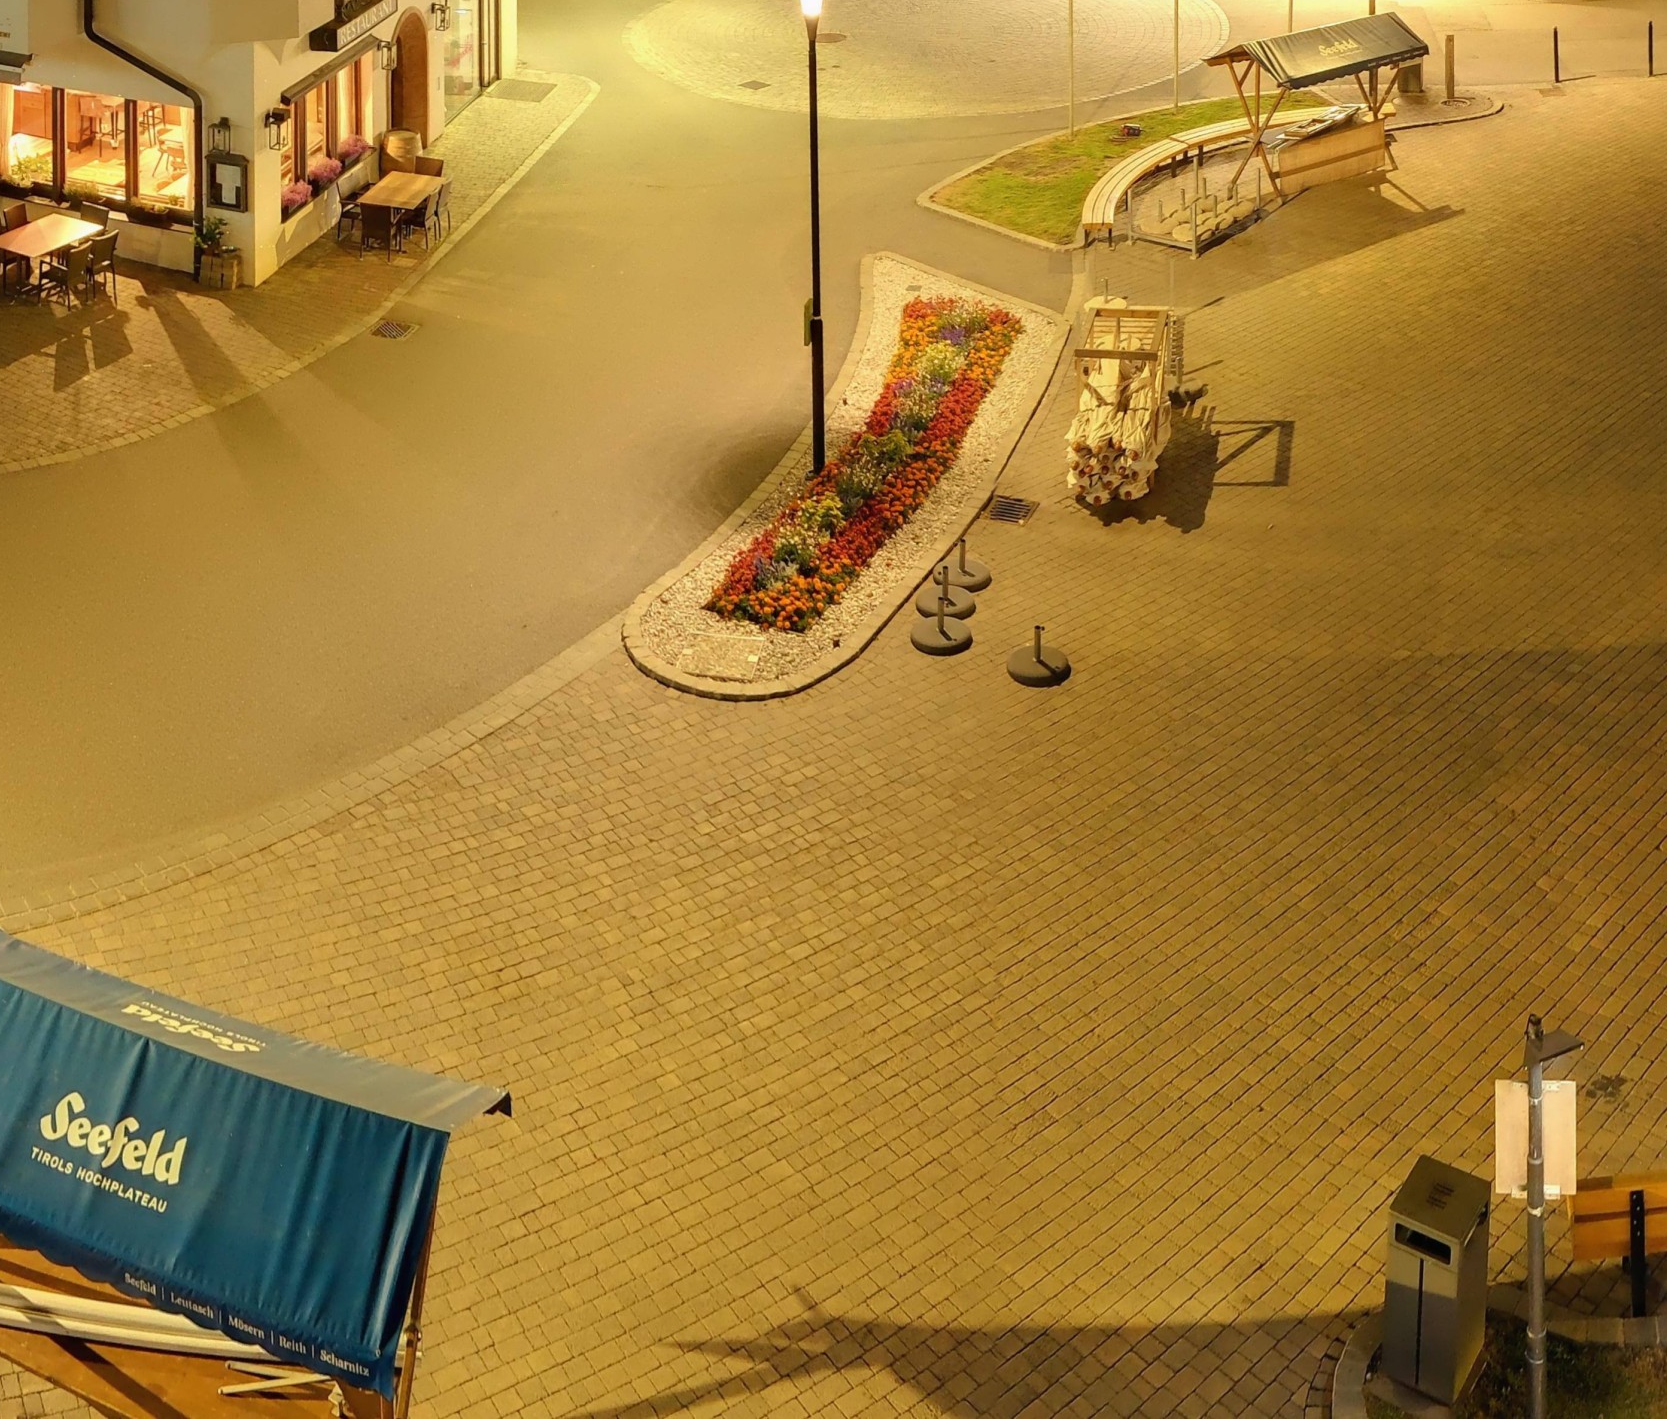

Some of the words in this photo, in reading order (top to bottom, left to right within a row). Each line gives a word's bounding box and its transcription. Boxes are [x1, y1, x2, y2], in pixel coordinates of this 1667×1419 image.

[1318, 38, 1360, 57] Seefeld
[121, 1002, 265, 1054] Seefeld
[140, 1000, 224, 1036] HOCHPLATEAU
[226, 1031, 267, 1048] TIROLS
[39, 1091, 188, 1185] Seefeld
[30, 1145, 74, 1175] TIROLS
[76, 1165, 168, 1214] HOCHPLATEAU
[124, 1272, 157, 1297] Seefeld
[170, 1291, 215, 1319] Leutasch
[228, 1314, 265, 1340] Mösern
[279, 1334, 307, 1355] Reith
[319, 1349, 370, 1377] Scharnitz
